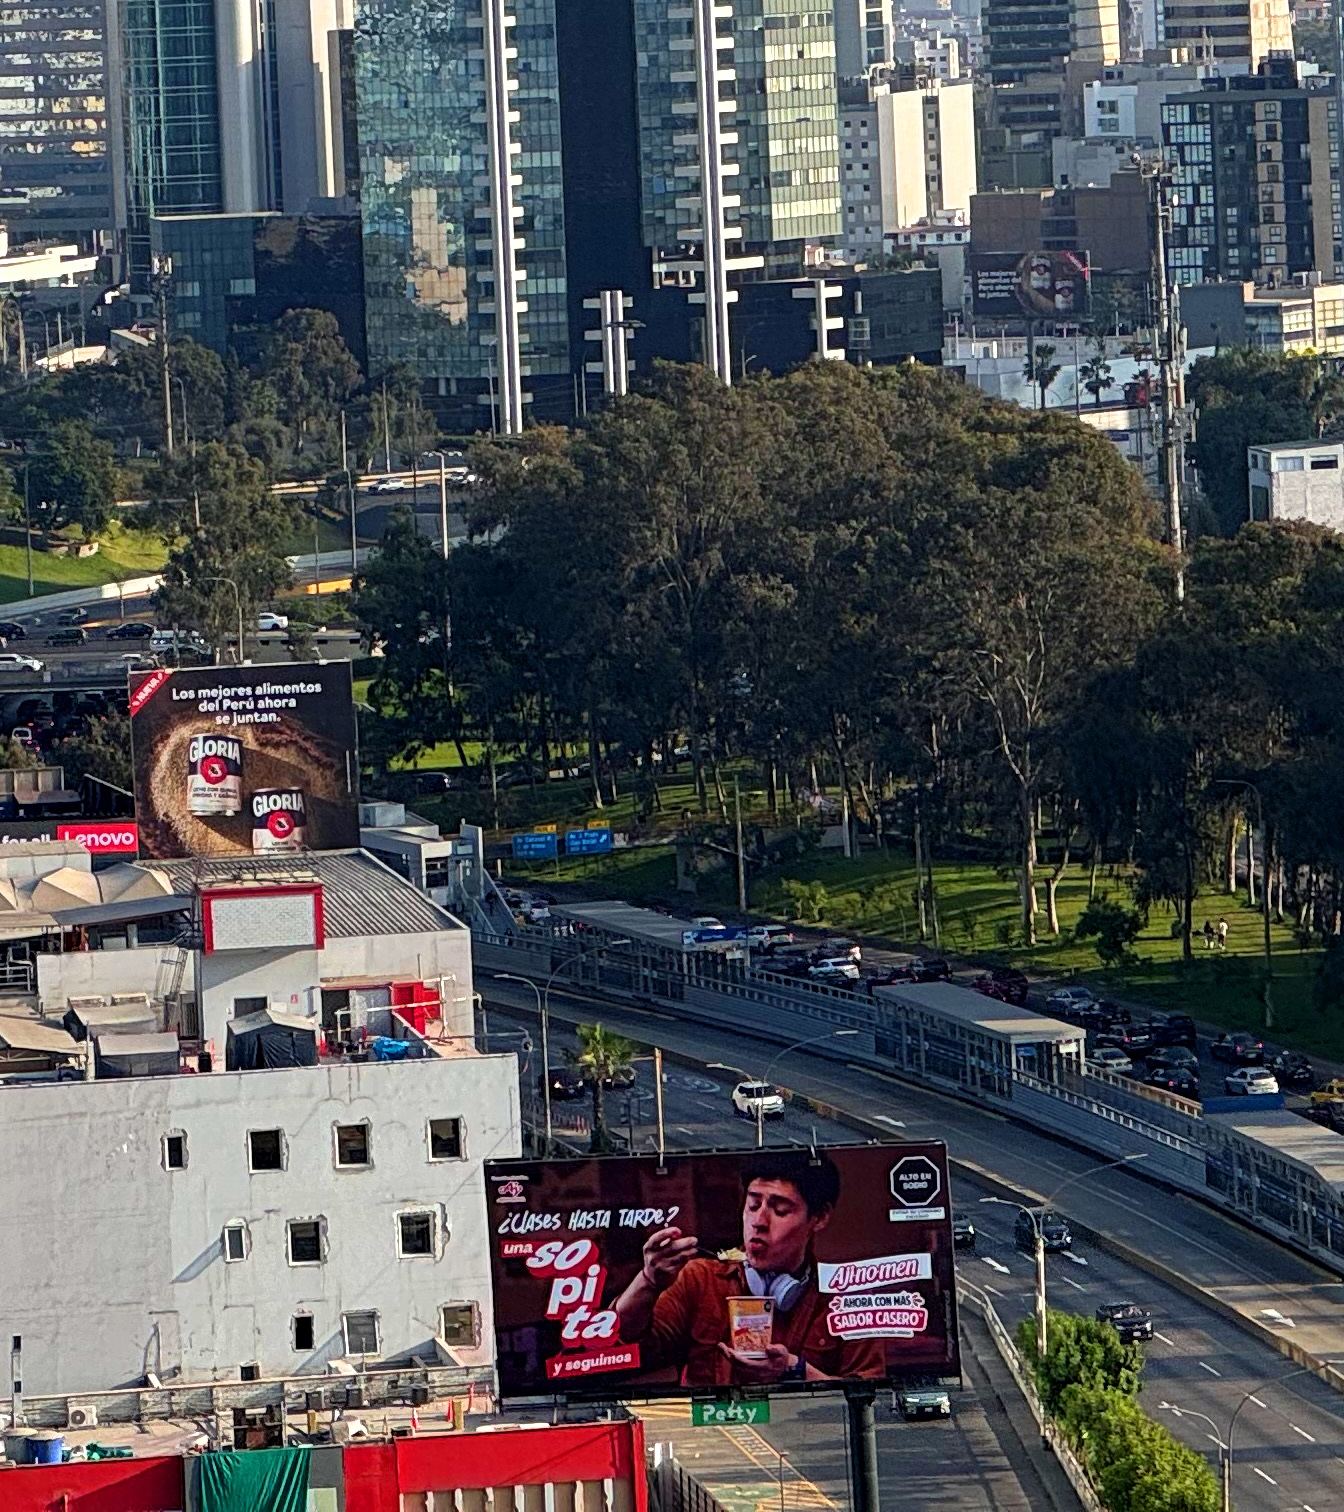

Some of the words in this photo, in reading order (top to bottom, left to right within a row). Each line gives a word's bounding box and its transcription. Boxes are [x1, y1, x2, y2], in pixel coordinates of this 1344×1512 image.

[172, 687, 196, 701] Los
[197, 684, 253, 700] mejores
[255, 681, 323, 696] alimentos
[198, 699, 220, 713] del
[222, 697, 255, 712] Perú
[257, 696, 297, 710] ahora
[215, 714, 231, 726] se
[232, 711, 282, 727] juntan.
[189, 739, 241, 765] GLORIA
[252, 792, 304, 817] GLORIA
[64, 831, 135, 847] Lenovo
[568, 1209, 612, 1231] HASTA
[503, 1243, 533, 1254] una
[525, 1239, 593, 1271] so
[546, 1264, 601, 1315] pi
[843, 1296, 873, 1308] AHORA
[874, 1296, 892, 1307] CON
[561, 1304, 618, 1340] ta
[833, 1312, 874, 1330] SABOR
[552, 1361, 562, 1377] y
[564, 1352, 632, 1372] seguimos
